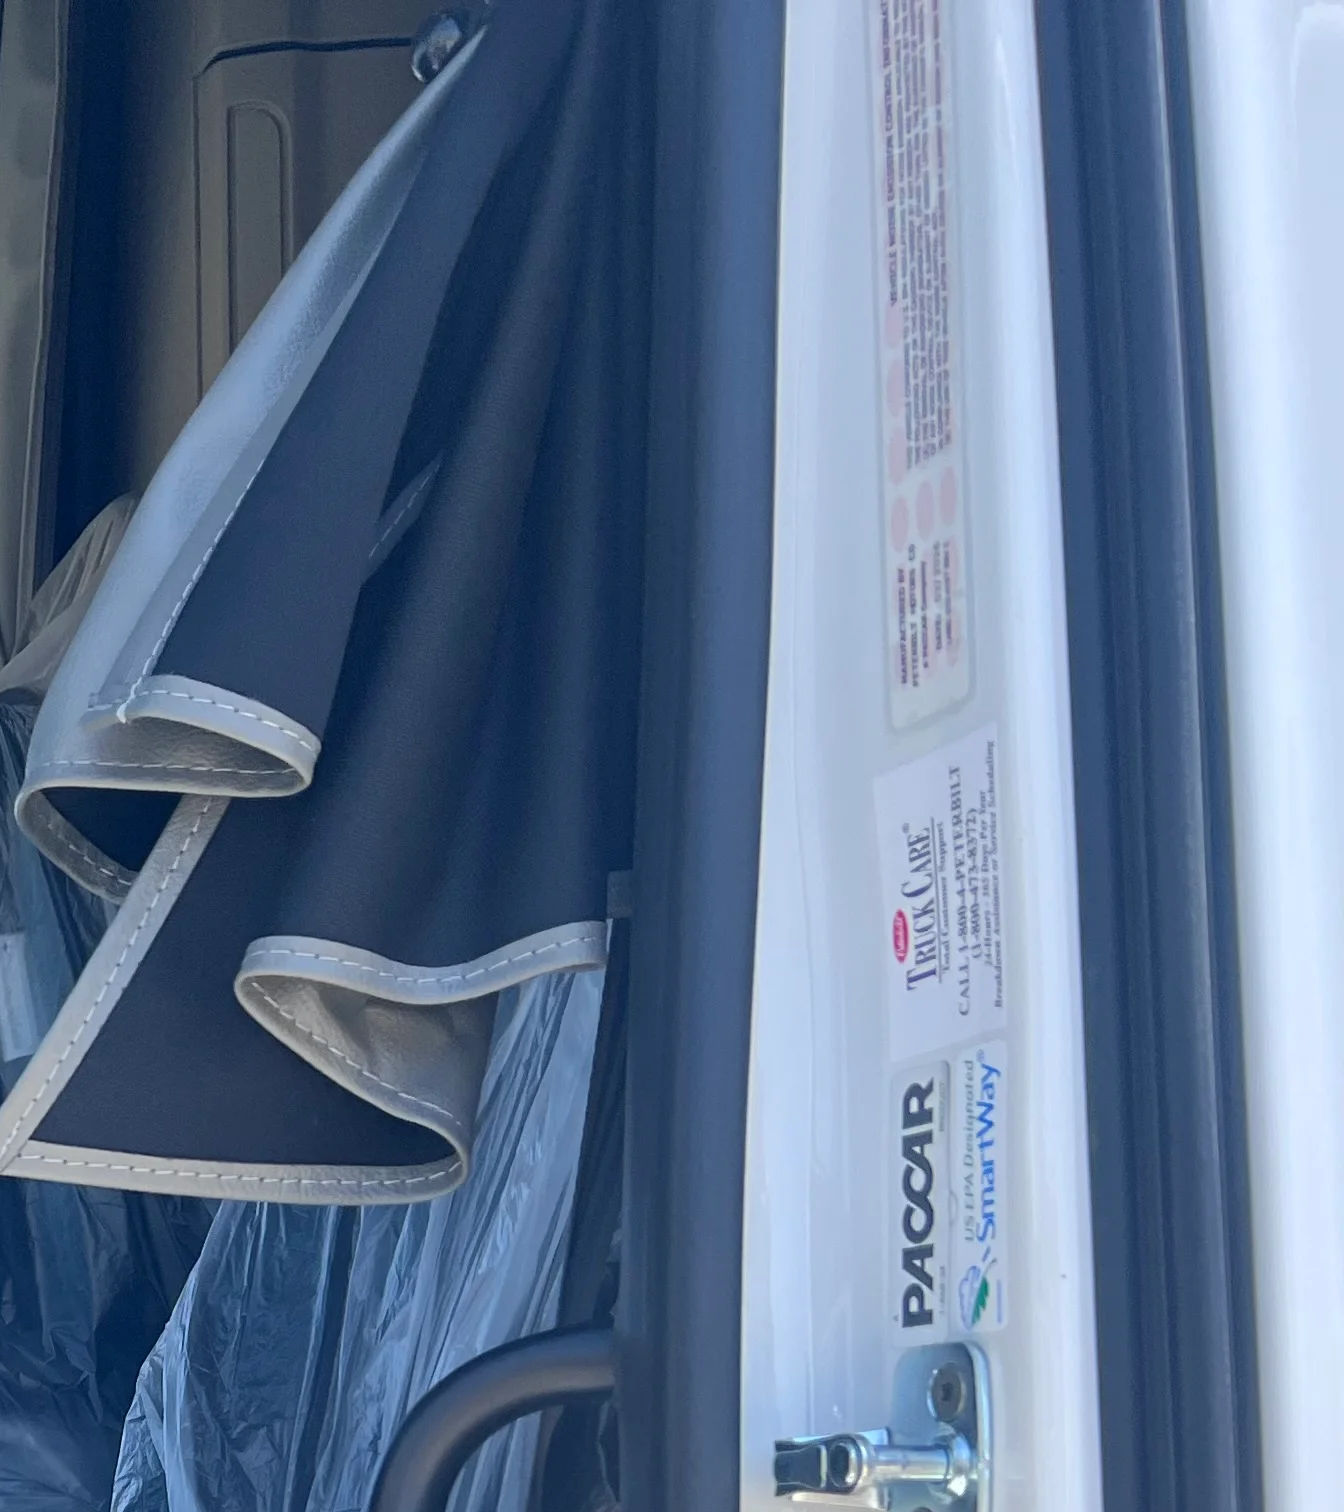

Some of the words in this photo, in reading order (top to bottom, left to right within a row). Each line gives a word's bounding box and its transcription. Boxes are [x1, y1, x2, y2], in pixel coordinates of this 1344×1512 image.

[900, 827, 933, 898] CARE
[937, 822, 947, 873] Support
[949, 766, 968, 954] 1-800-4-PETERBILT
[965, 807, 983, 959] (1-800-473-8372)
[940, 876, 949, 937] Customer
[906, 898, 937, 991] TRUCK
[941, 940, 950, 973] Total
[958, 956, 969, 1017] CALL
[962, 1060, 976, 1170] Designated
[975, 1062, 1001, 1243] SmartWay
[901, 1077, 933, 1328] PACCAR
[963, 1173, 974, 1210] EPA
[963, 1215, 974, 1243] US
